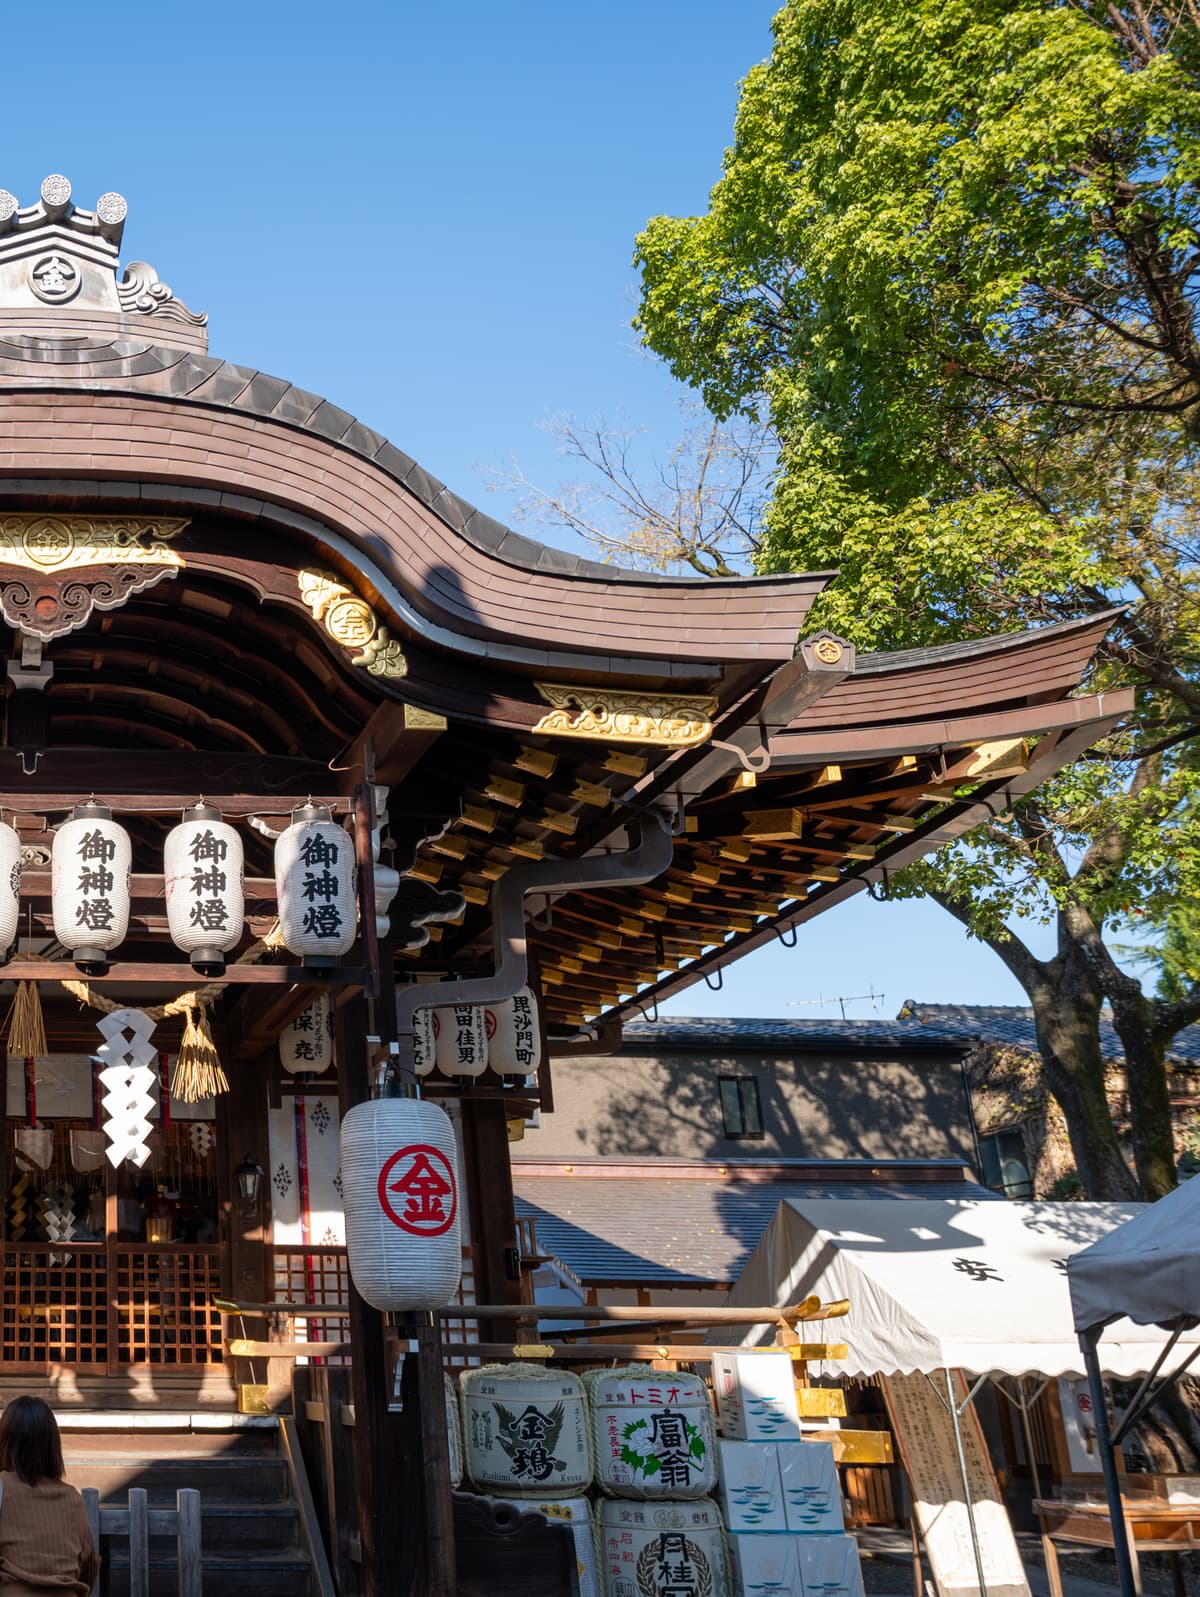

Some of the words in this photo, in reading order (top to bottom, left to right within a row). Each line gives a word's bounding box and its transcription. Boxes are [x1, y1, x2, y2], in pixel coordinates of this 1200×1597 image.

[33, 257, 75, 292] 金
[75, 828, 116, 931] 御神燈
[189, 829, 228, 931] 御神燈
[299, 832, 343, 939] 御神燈
[512, 996, 535, 1066] 毘沙門町
[388, 1153, 452, 1223] 金
[631, 1387, 693, 1405] トミオー
[650, 1408, 693, 1487] 富翁
